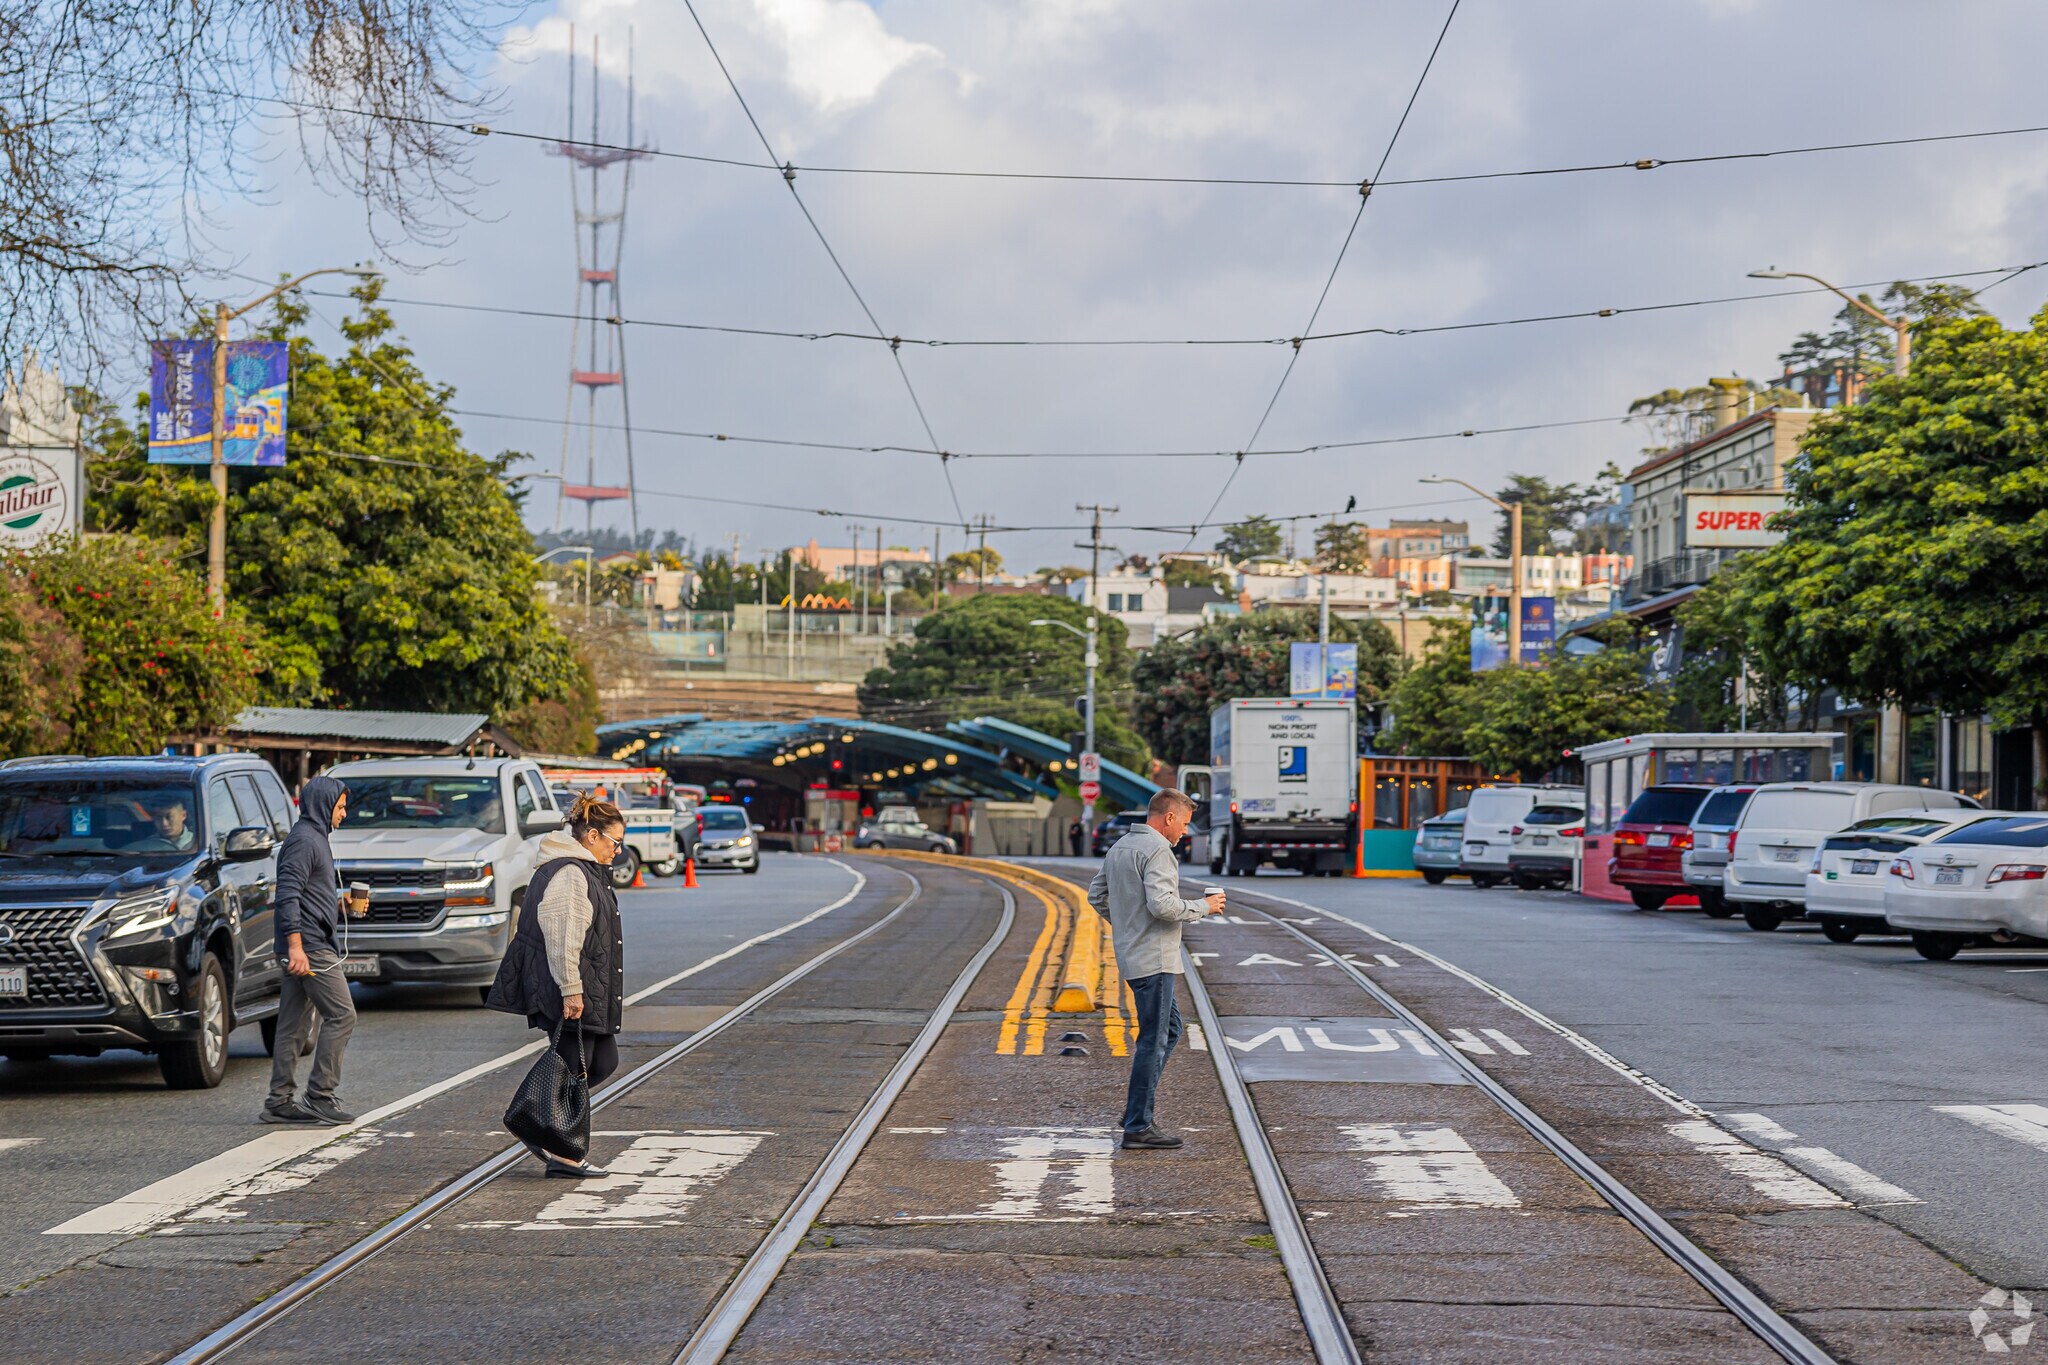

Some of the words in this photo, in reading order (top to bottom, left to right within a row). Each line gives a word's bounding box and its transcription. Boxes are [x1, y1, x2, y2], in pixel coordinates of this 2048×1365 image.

[176, 348, 193, 400] PORTAL
[156, 411, 174, 440] DINE
[1189, 915, 1321, 925] NLY
[342, 963, 376, 975] 9379L2
[1190, 953, 1401, 968] TAXI
[1185, 1022, 1532, 1056] MUNI
